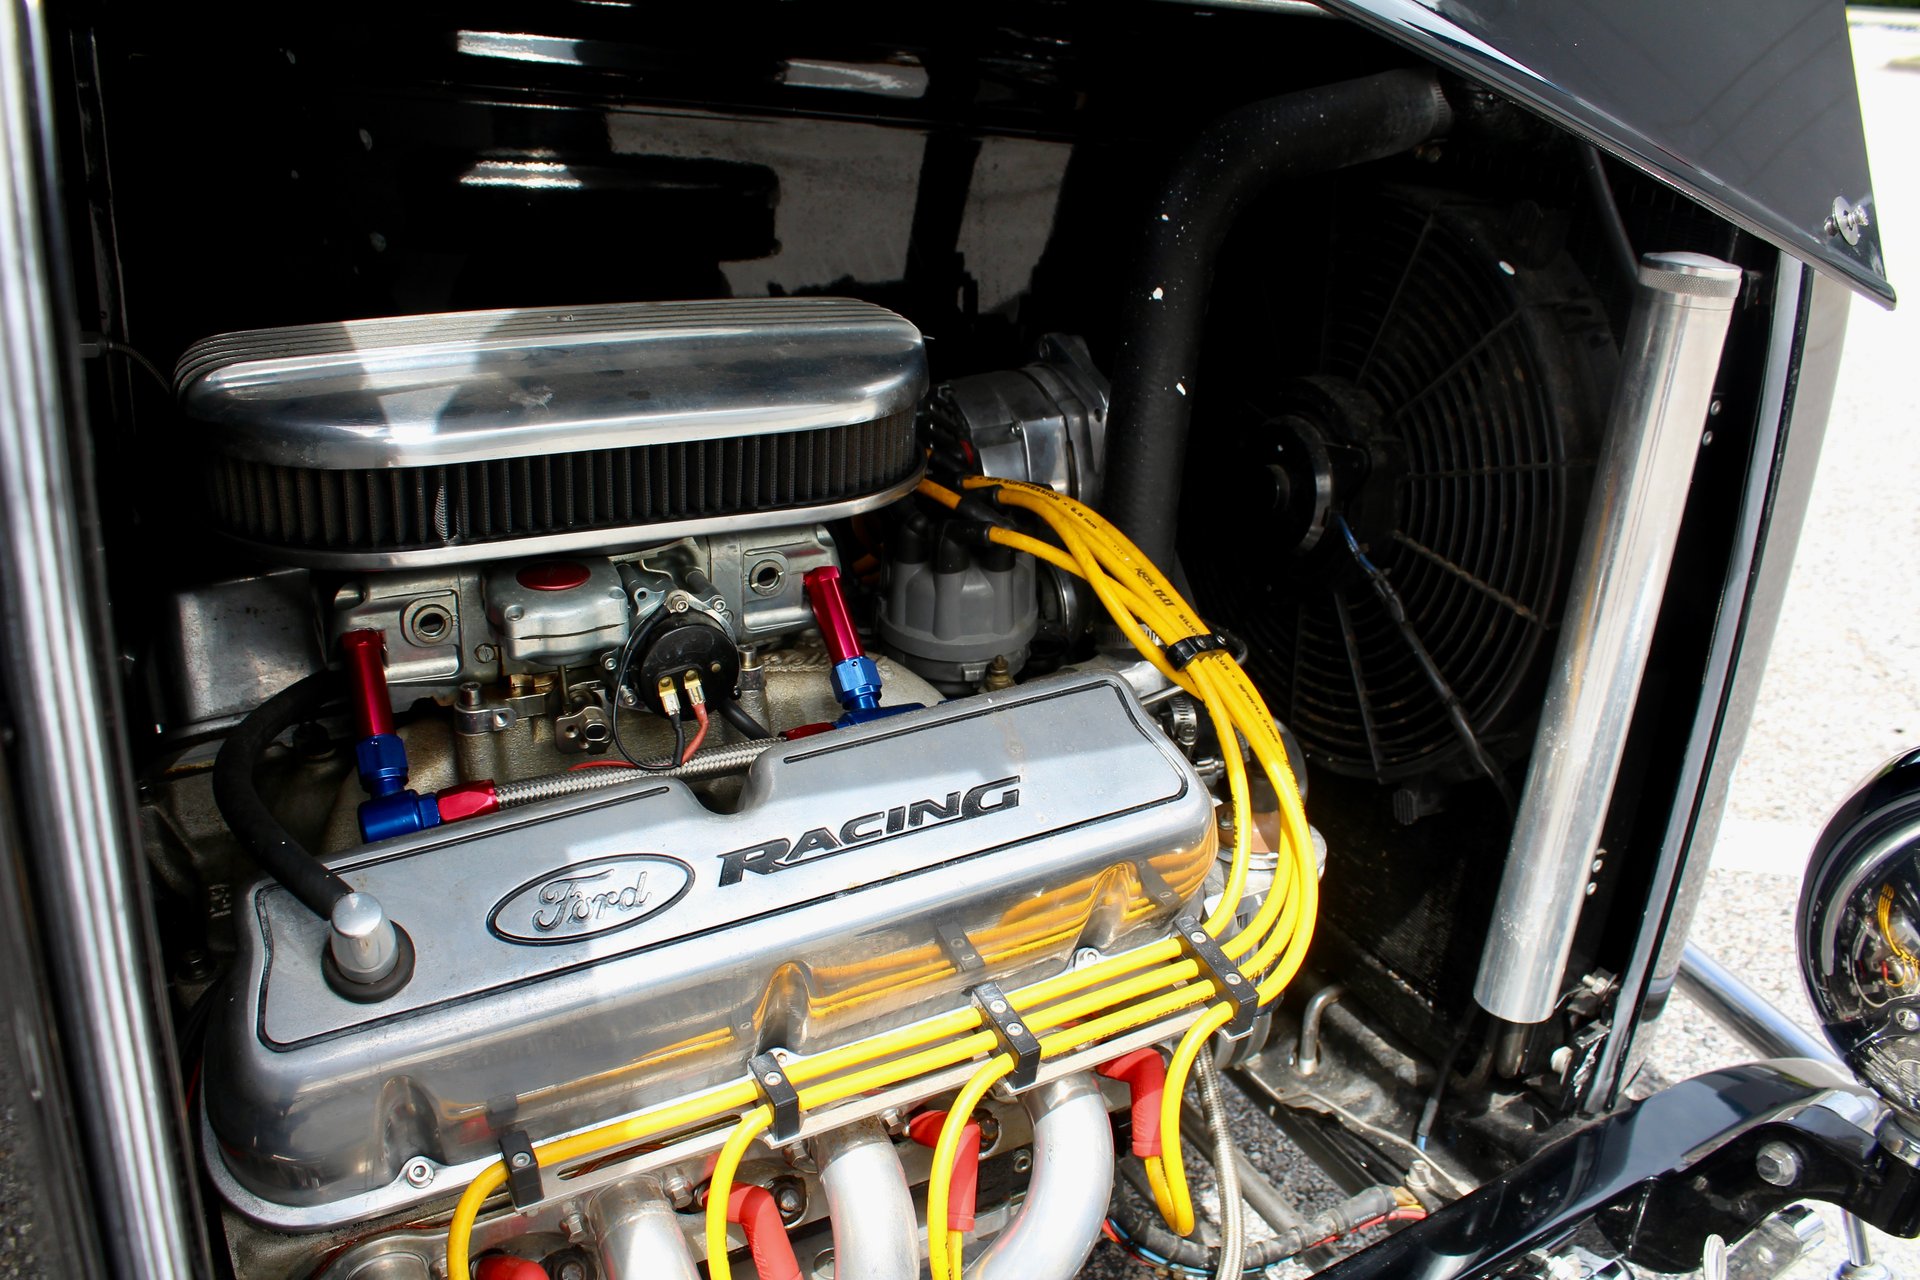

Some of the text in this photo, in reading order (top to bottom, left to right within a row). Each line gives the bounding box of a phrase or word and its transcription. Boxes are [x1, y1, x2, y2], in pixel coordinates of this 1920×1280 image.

[1005, 479, 1060, 501] SUPPRESSION
[534, 775, 1021, 933] Ford RACING
